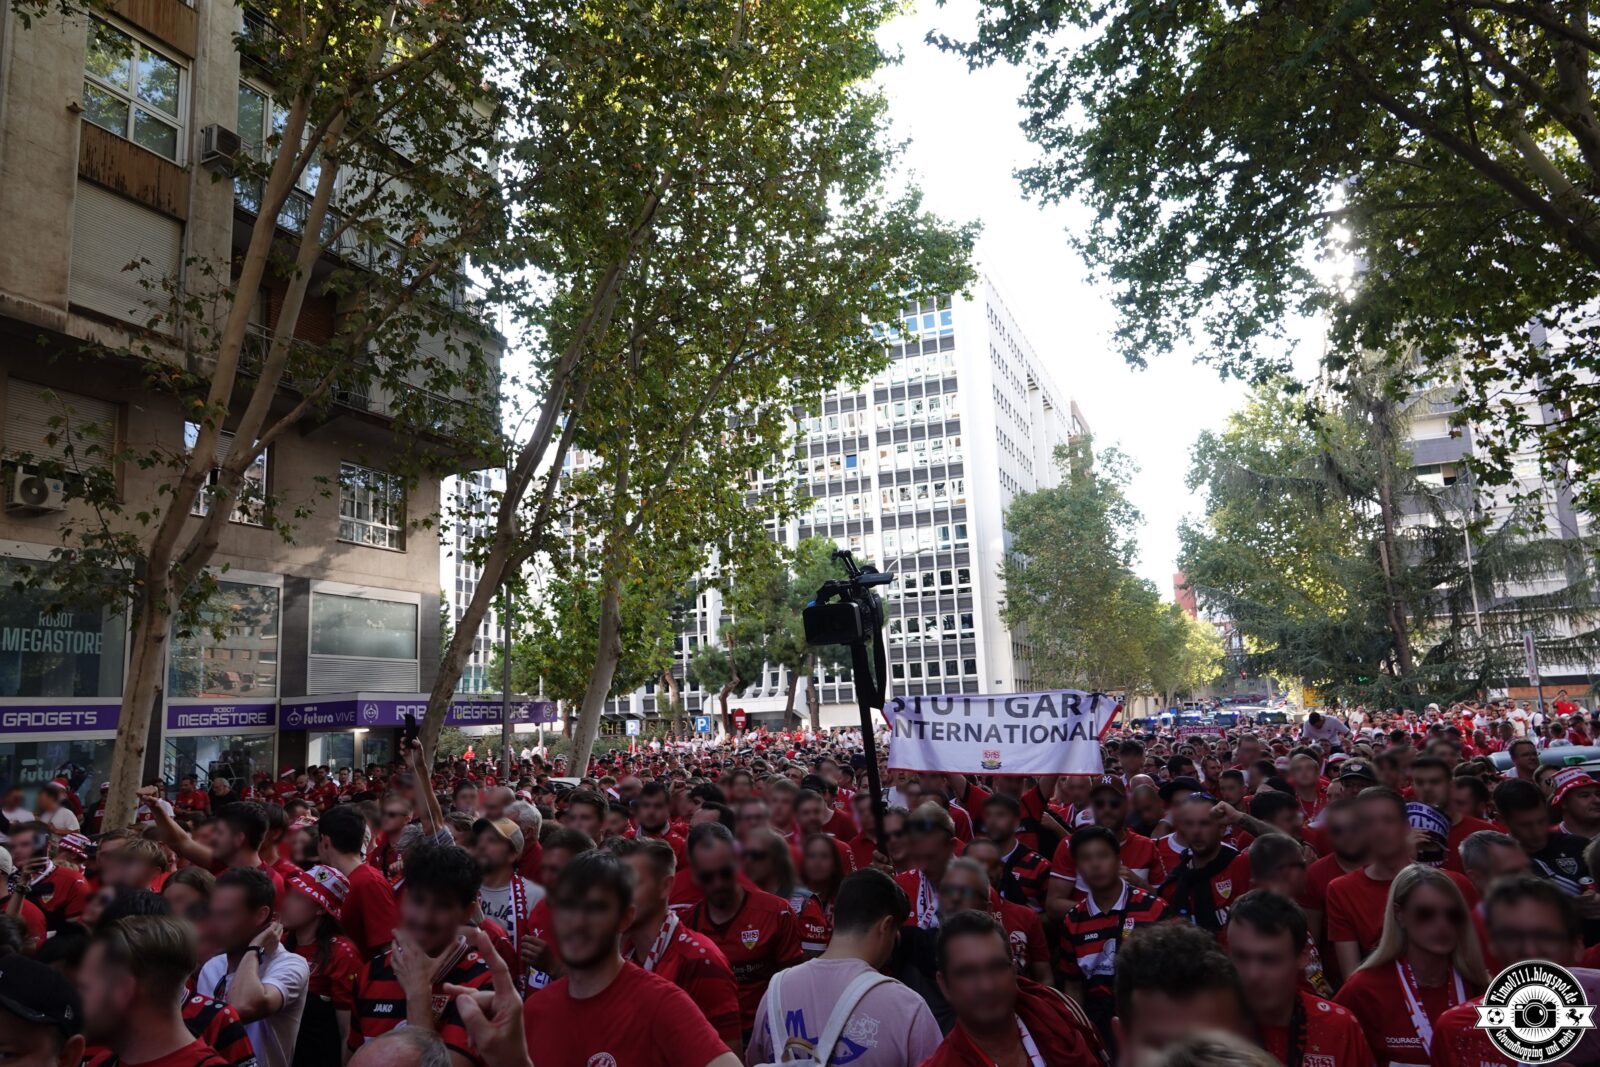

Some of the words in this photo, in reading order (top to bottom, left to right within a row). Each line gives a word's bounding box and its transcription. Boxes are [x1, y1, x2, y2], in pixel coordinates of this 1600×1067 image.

[38, 611, 74, 627] ROBOT
[2, 627, 103, 654] MEGASTORE
[2, 711, 98, 727] GADGETS
[177, 712, 267, 726] MEGASTORE
[303, 712, 334, 725] futura
[335, 711, 356, 723] VIVE
[395, 705, 427, 720] ROB
[697, 718, 707, 730] P
[895, 719, 1101, 744] NTERNATIONAL
[373, 1003, 394, 1013] JAKO
